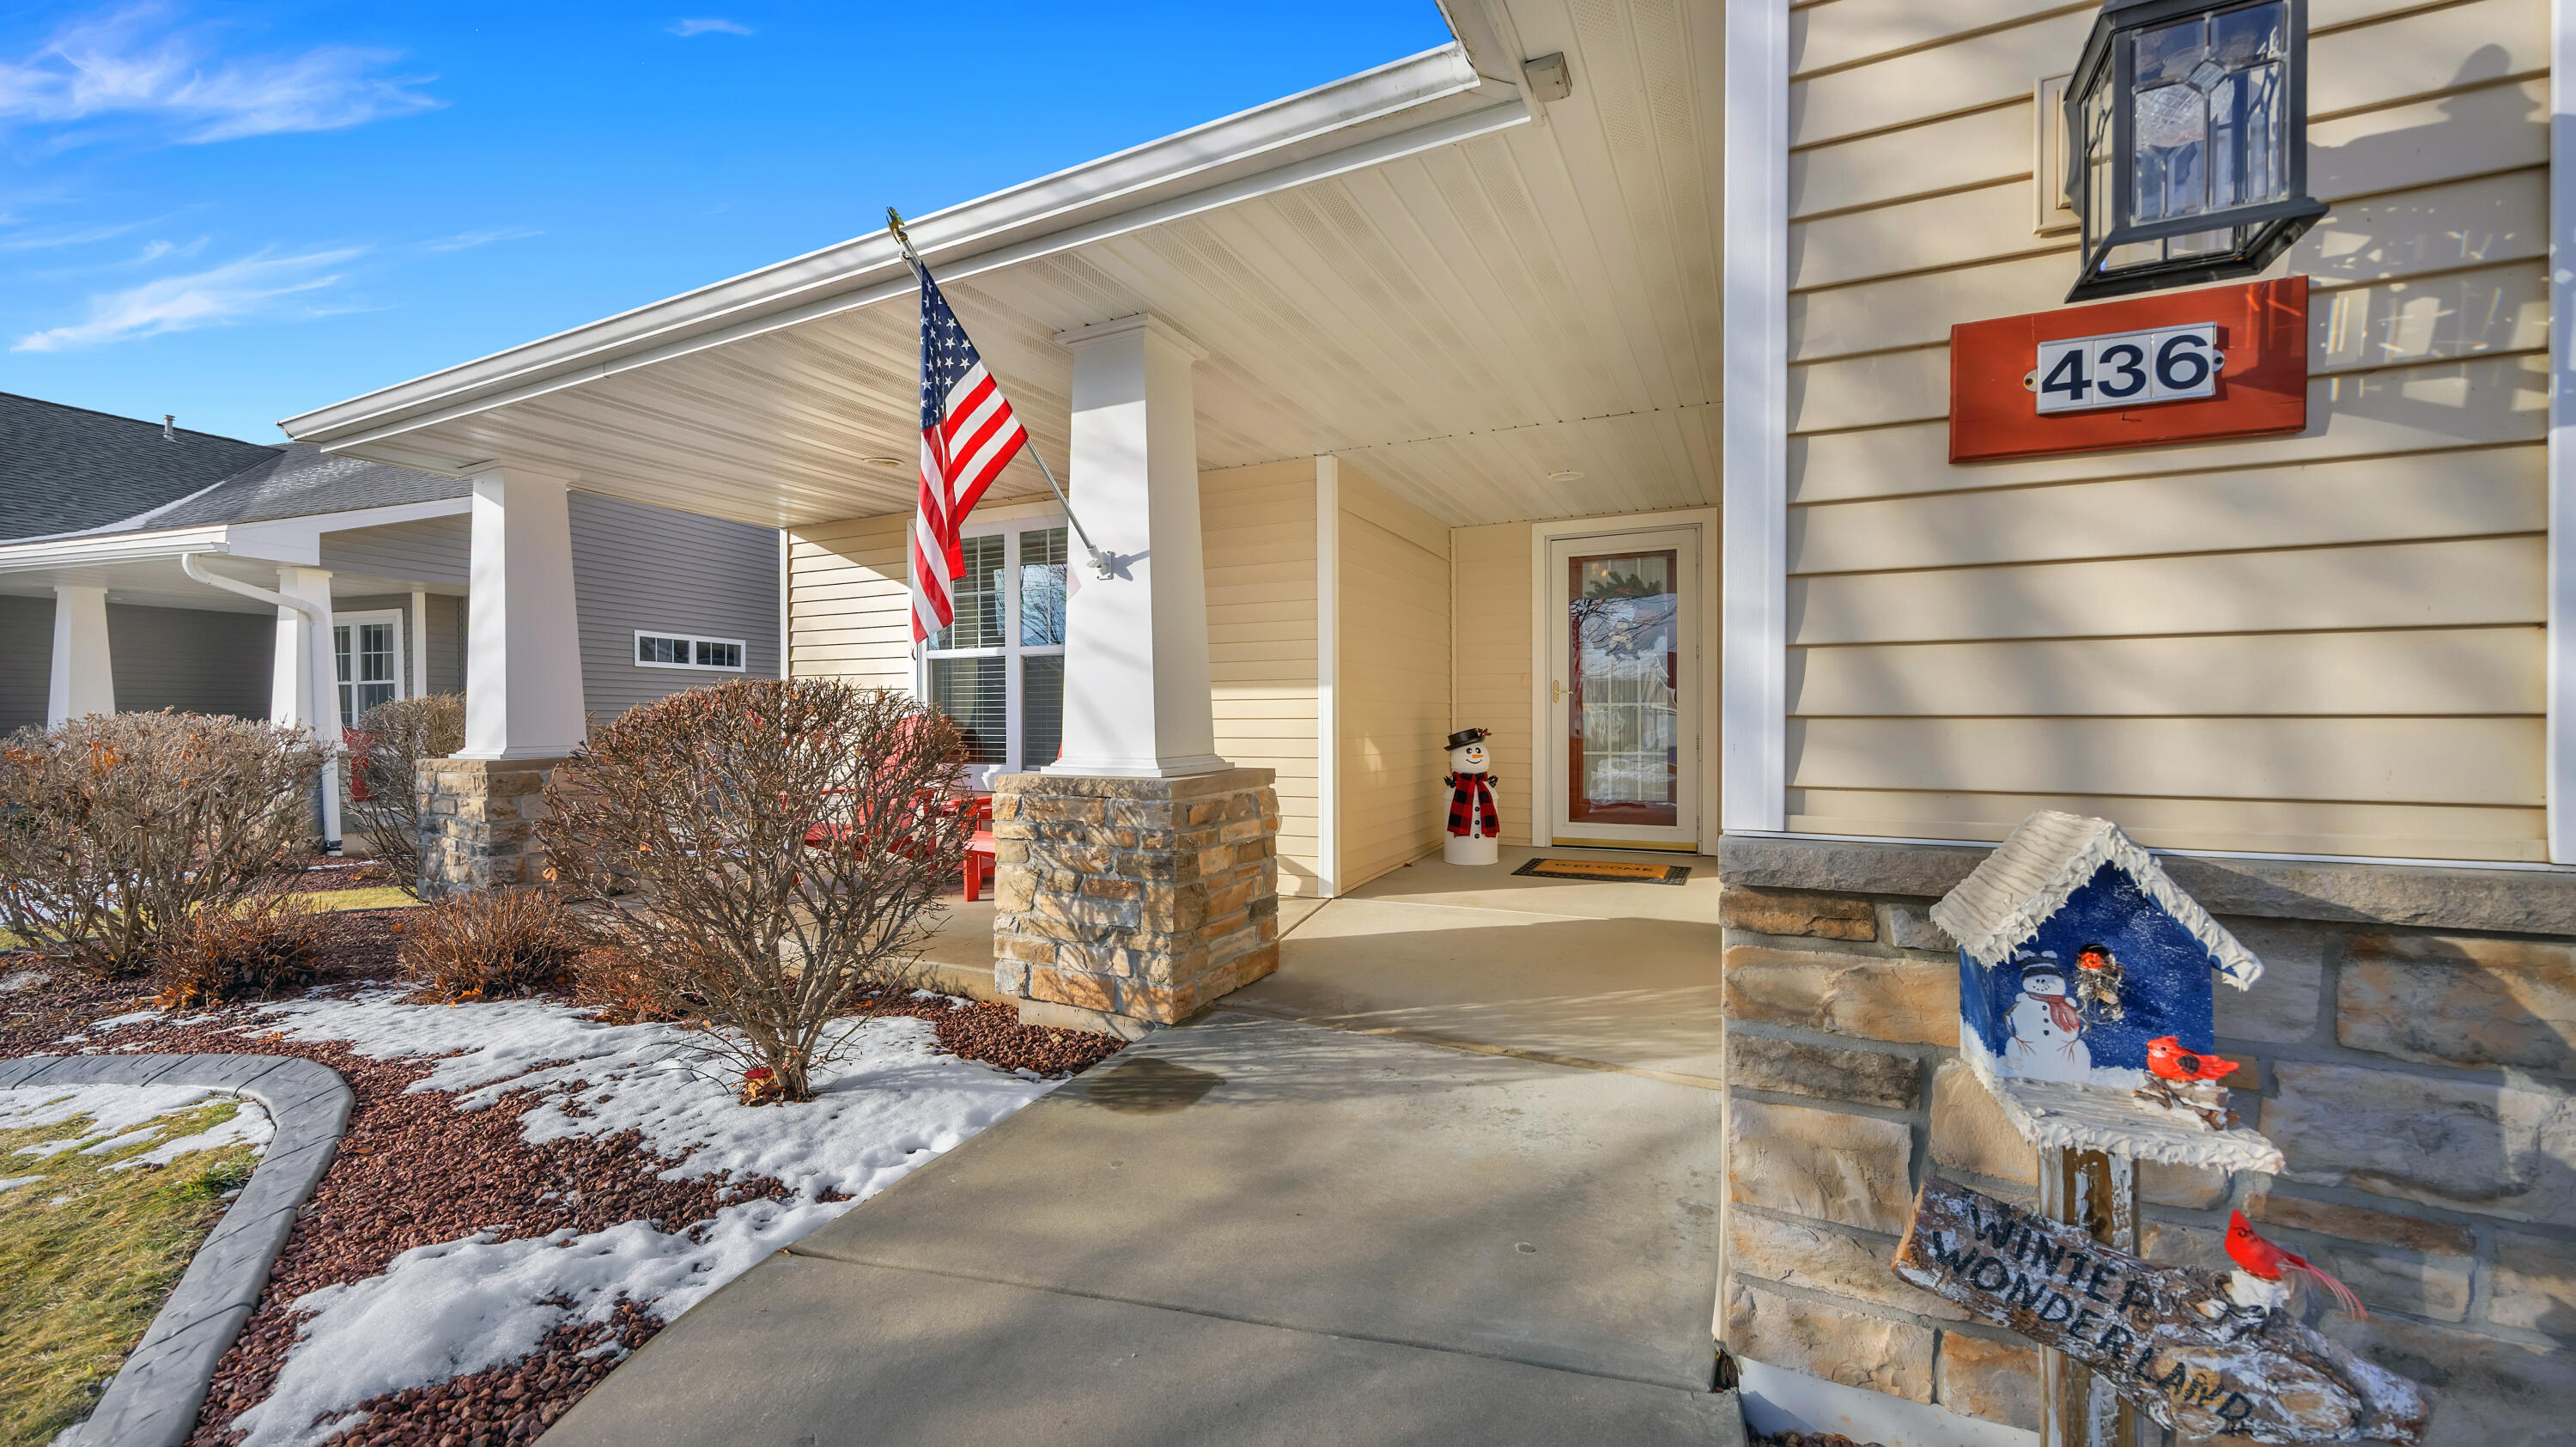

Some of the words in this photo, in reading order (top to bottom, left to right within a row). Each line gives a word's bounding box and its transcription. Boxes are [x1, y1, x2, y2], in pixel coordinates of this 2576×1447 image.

[2041, 334, 2210, 401] 436
[1554, 863, 1653, 872] WELCOME
[1970, 1203, 2154, 1313] WINTER
[1932, 1231, 2253, 1421] WONDERLAND
